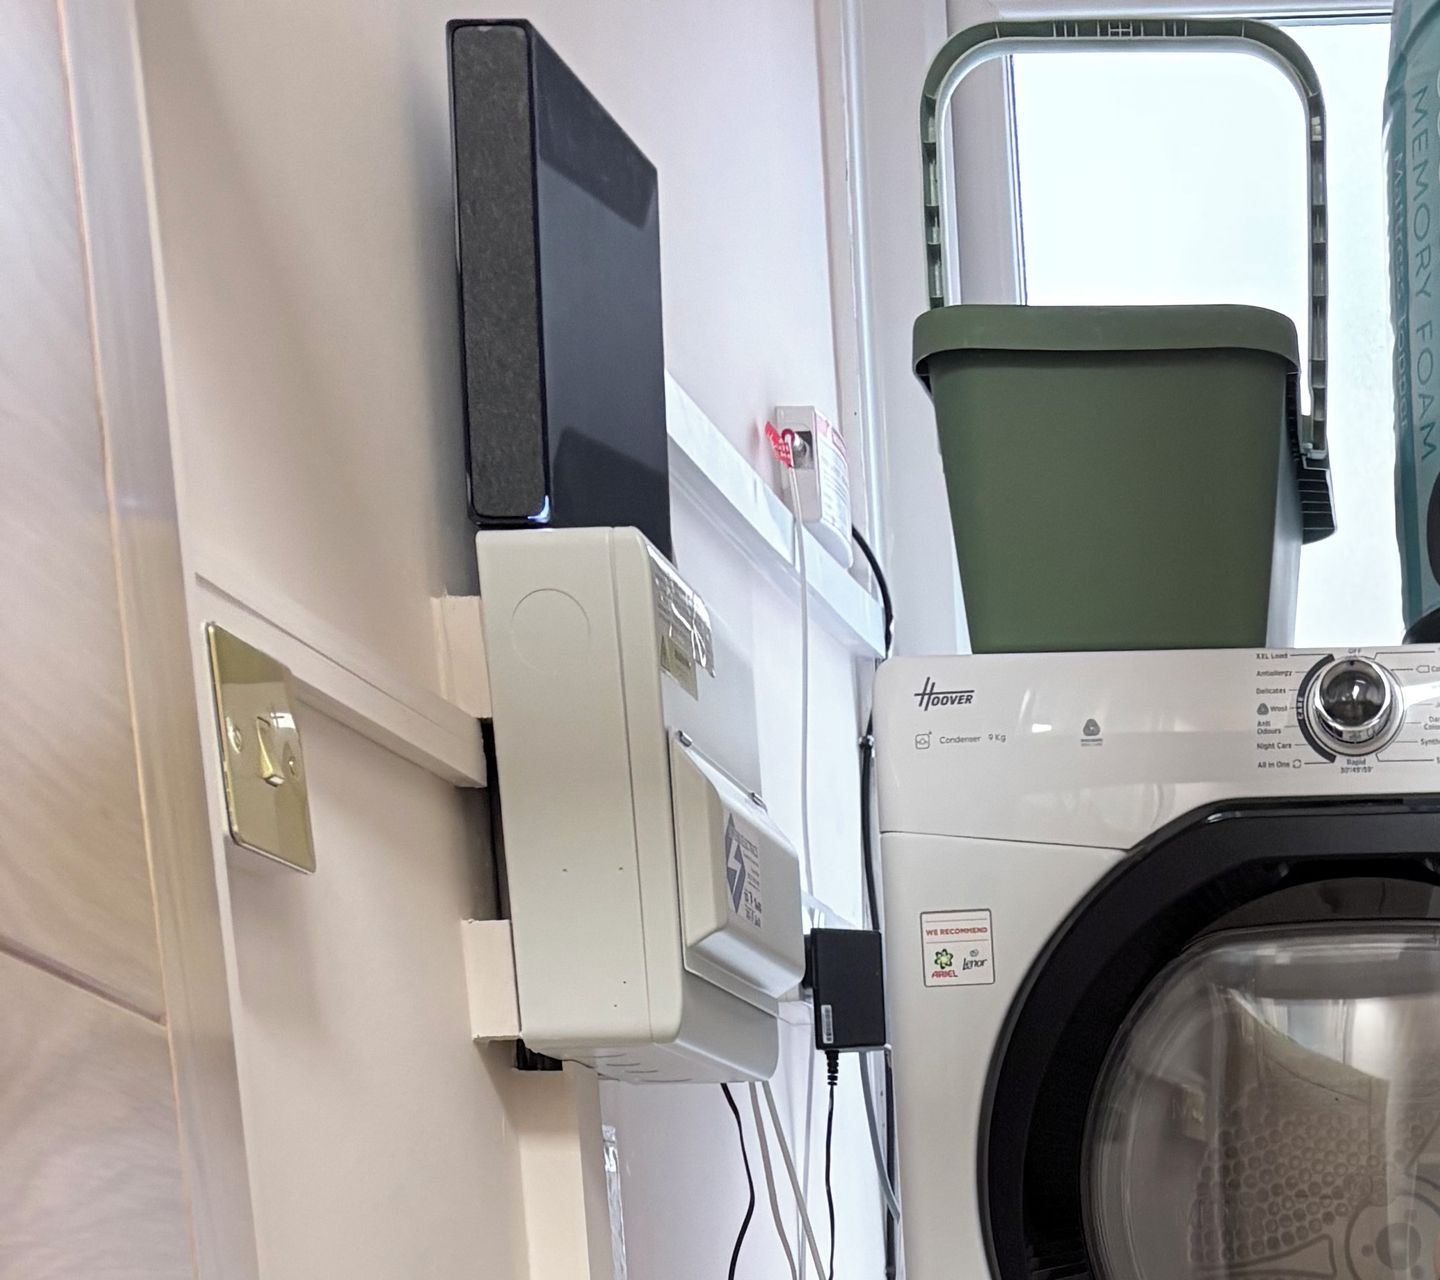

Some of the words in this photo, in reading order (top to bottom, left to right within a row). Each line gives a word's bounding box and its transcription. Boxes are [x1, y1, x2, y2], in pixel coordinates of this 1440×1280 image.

[1411, 84, 1434, 299] MEMORY
[1415, 320, 1437, 460] FOAM
[914, 676, 975, 711] HOOVER
[939, 736, 982, 745] Condenser
[1257, 742, 1278, 751] Night
[940, 927, 988, 935] RECOMMEND
[962, 958, 988, 971] Lenor
[931, 970, 958, 978] ARIEL
